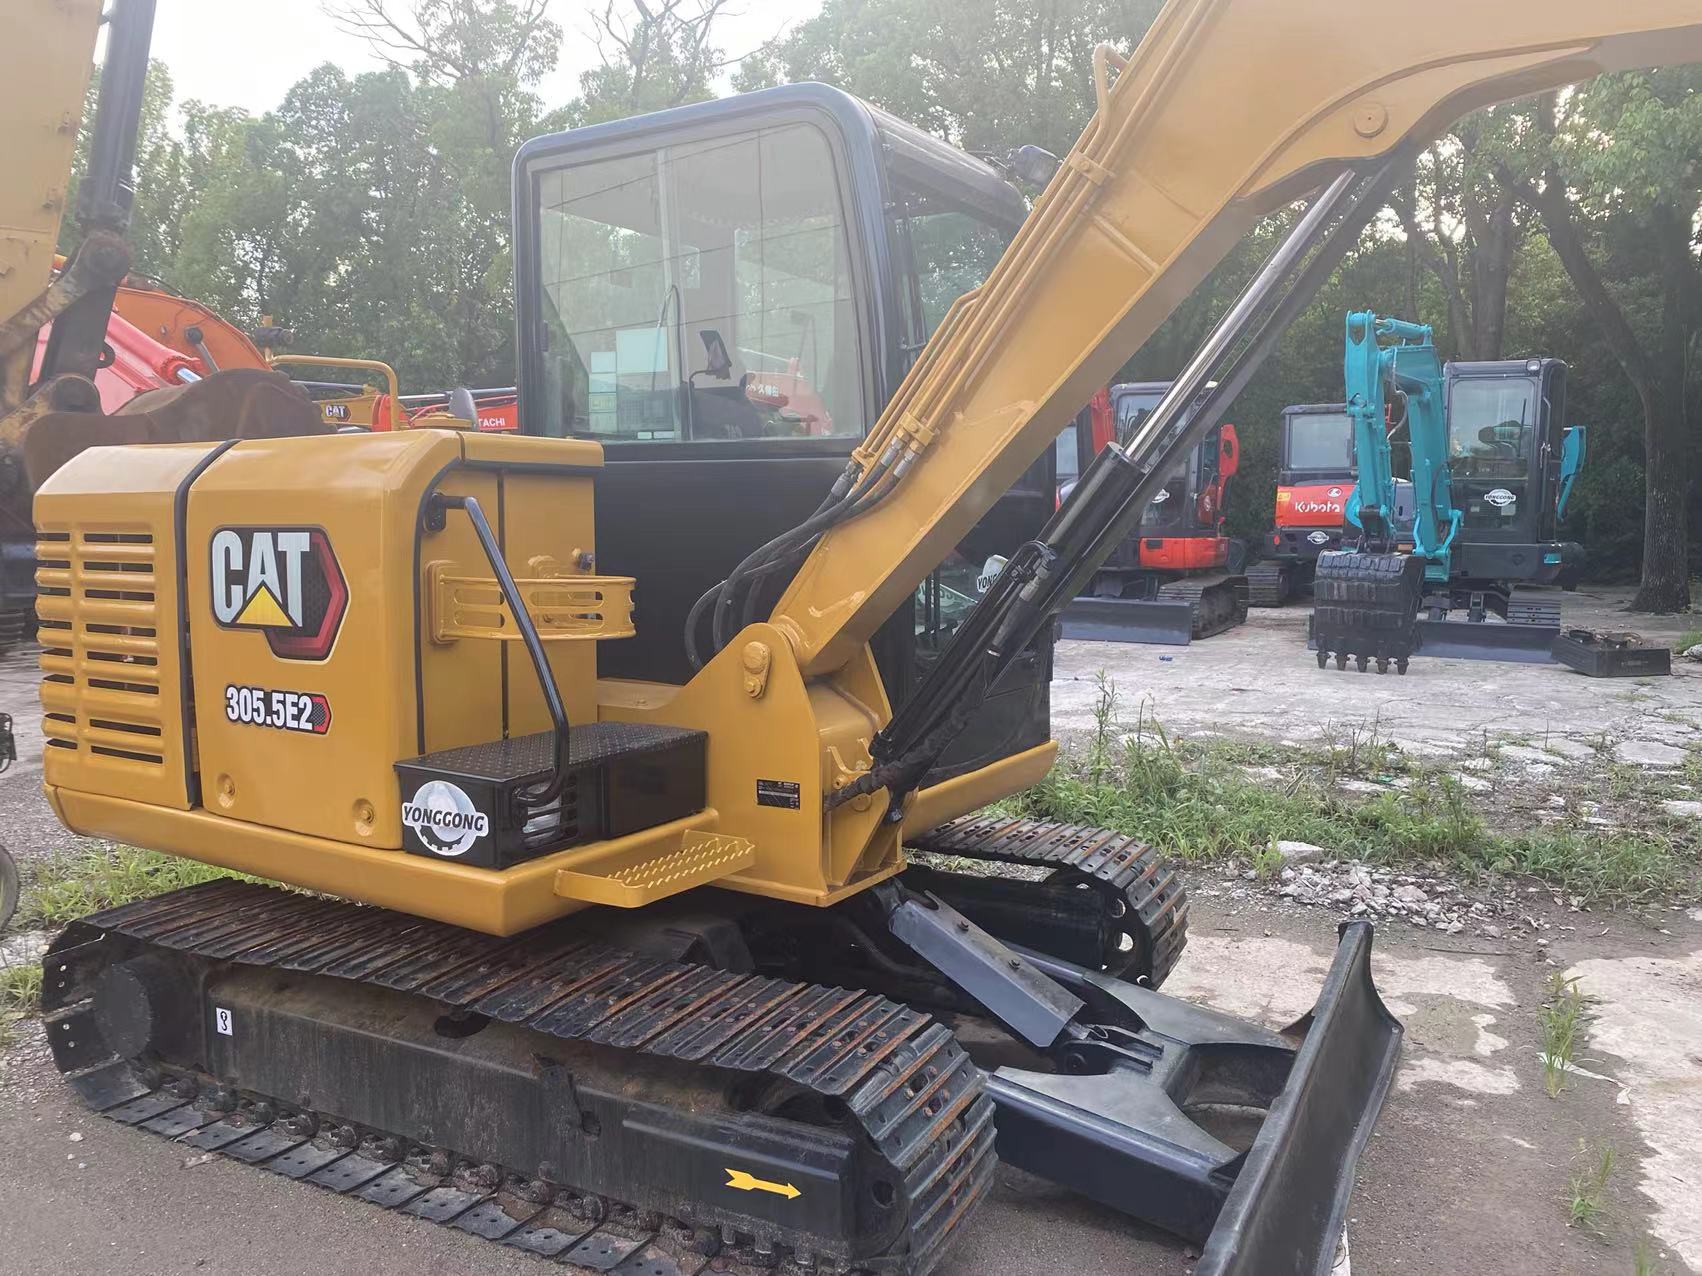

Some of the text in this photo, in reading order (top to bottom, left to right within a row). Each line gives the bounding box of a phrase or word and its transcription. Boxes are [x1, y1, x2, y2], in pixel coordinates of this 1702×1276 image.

[326, 405, 346, 418] CAT
[1295, 501, 1340, 513] Kubota
[211, 530, 310, 628] CAT
[226, 686, 314, 731] 305.5E2
[403, 805, 486, 832] YONGGONG
